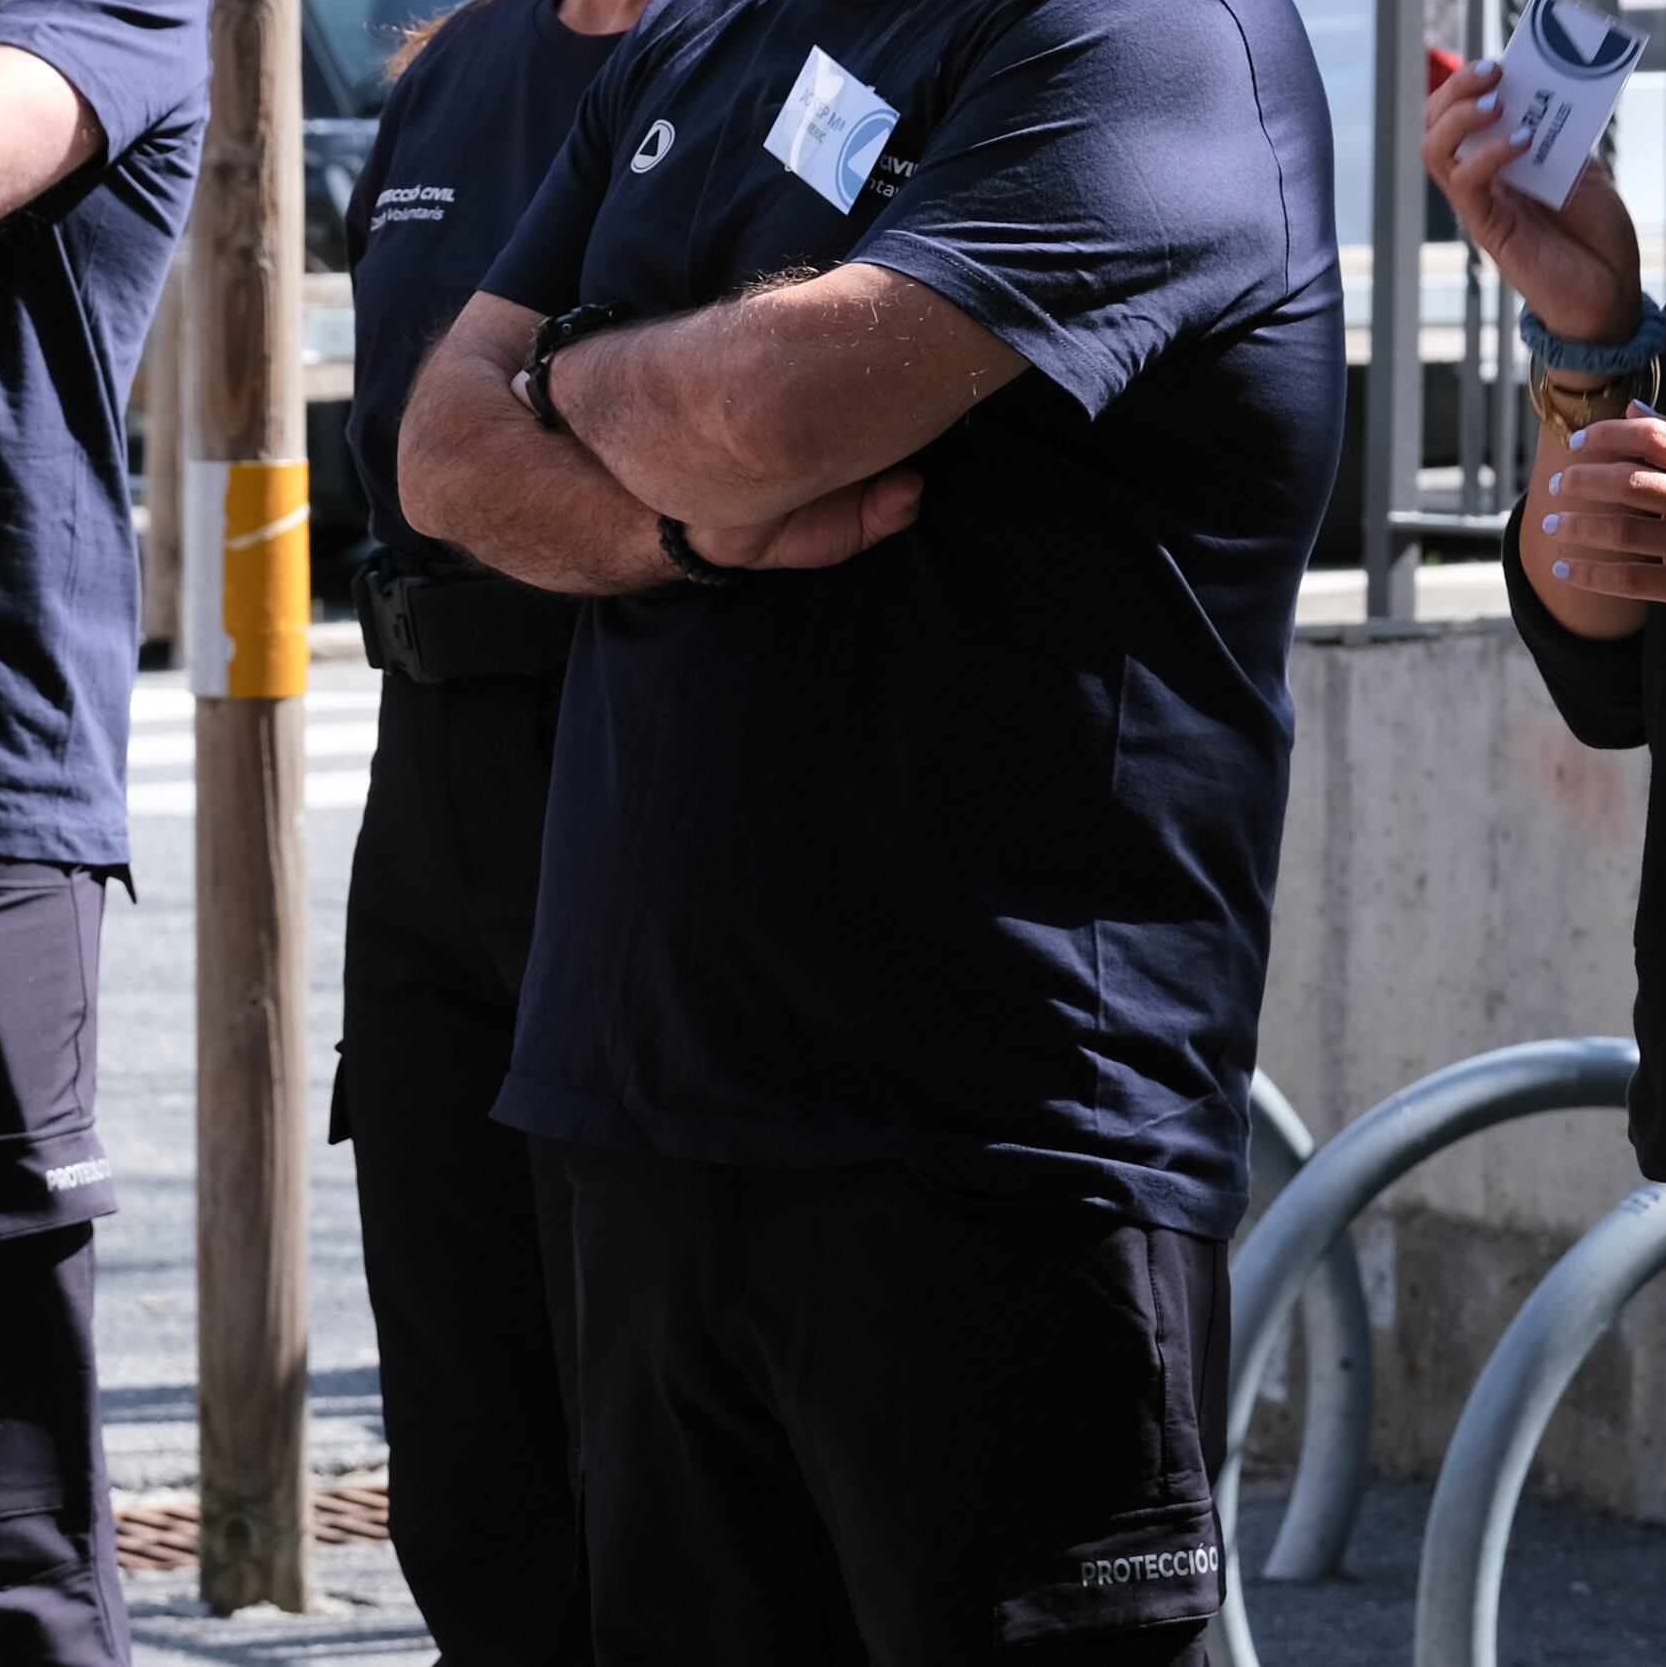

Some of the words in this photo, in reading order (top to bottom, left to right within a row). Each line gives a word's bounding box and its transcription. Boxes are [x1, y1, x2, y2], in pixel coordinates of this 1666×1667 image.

[1520, 88, 1556, 132] RLA
[420, 187, 455, 202] CIVIL
[1081, 1543, 1209, 1588] PROTECCIÓ
